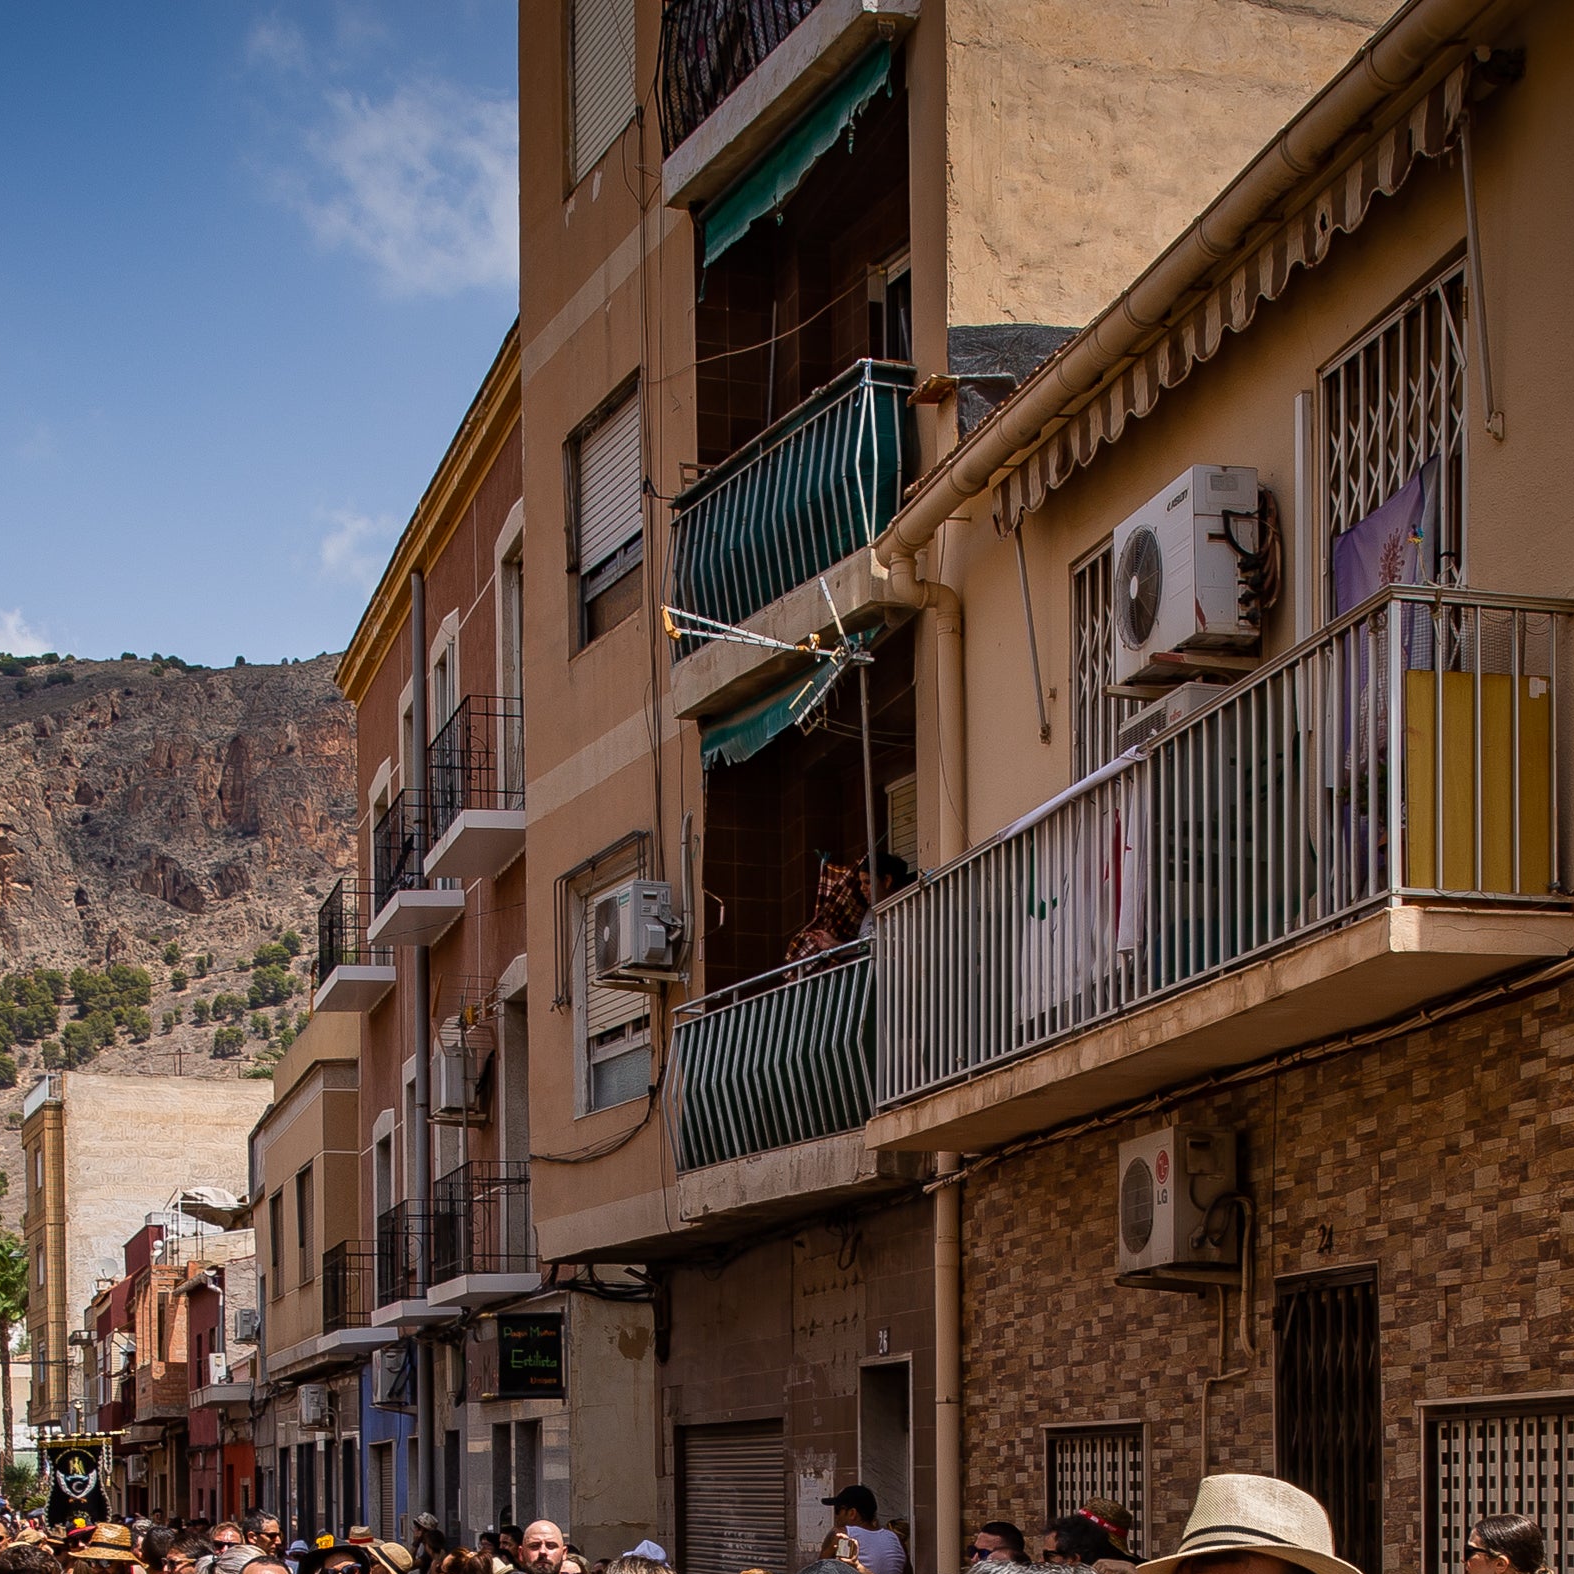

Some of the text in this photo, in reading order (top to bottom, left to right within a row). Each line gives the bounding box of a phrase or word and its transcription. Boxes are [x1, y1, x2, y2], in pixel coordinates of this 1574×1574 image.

[1157, 1188, 1168, 1206] LG
[1316, 1223, 1334, 1255] 24
[510, 1349, 558, 1369] Estilista
